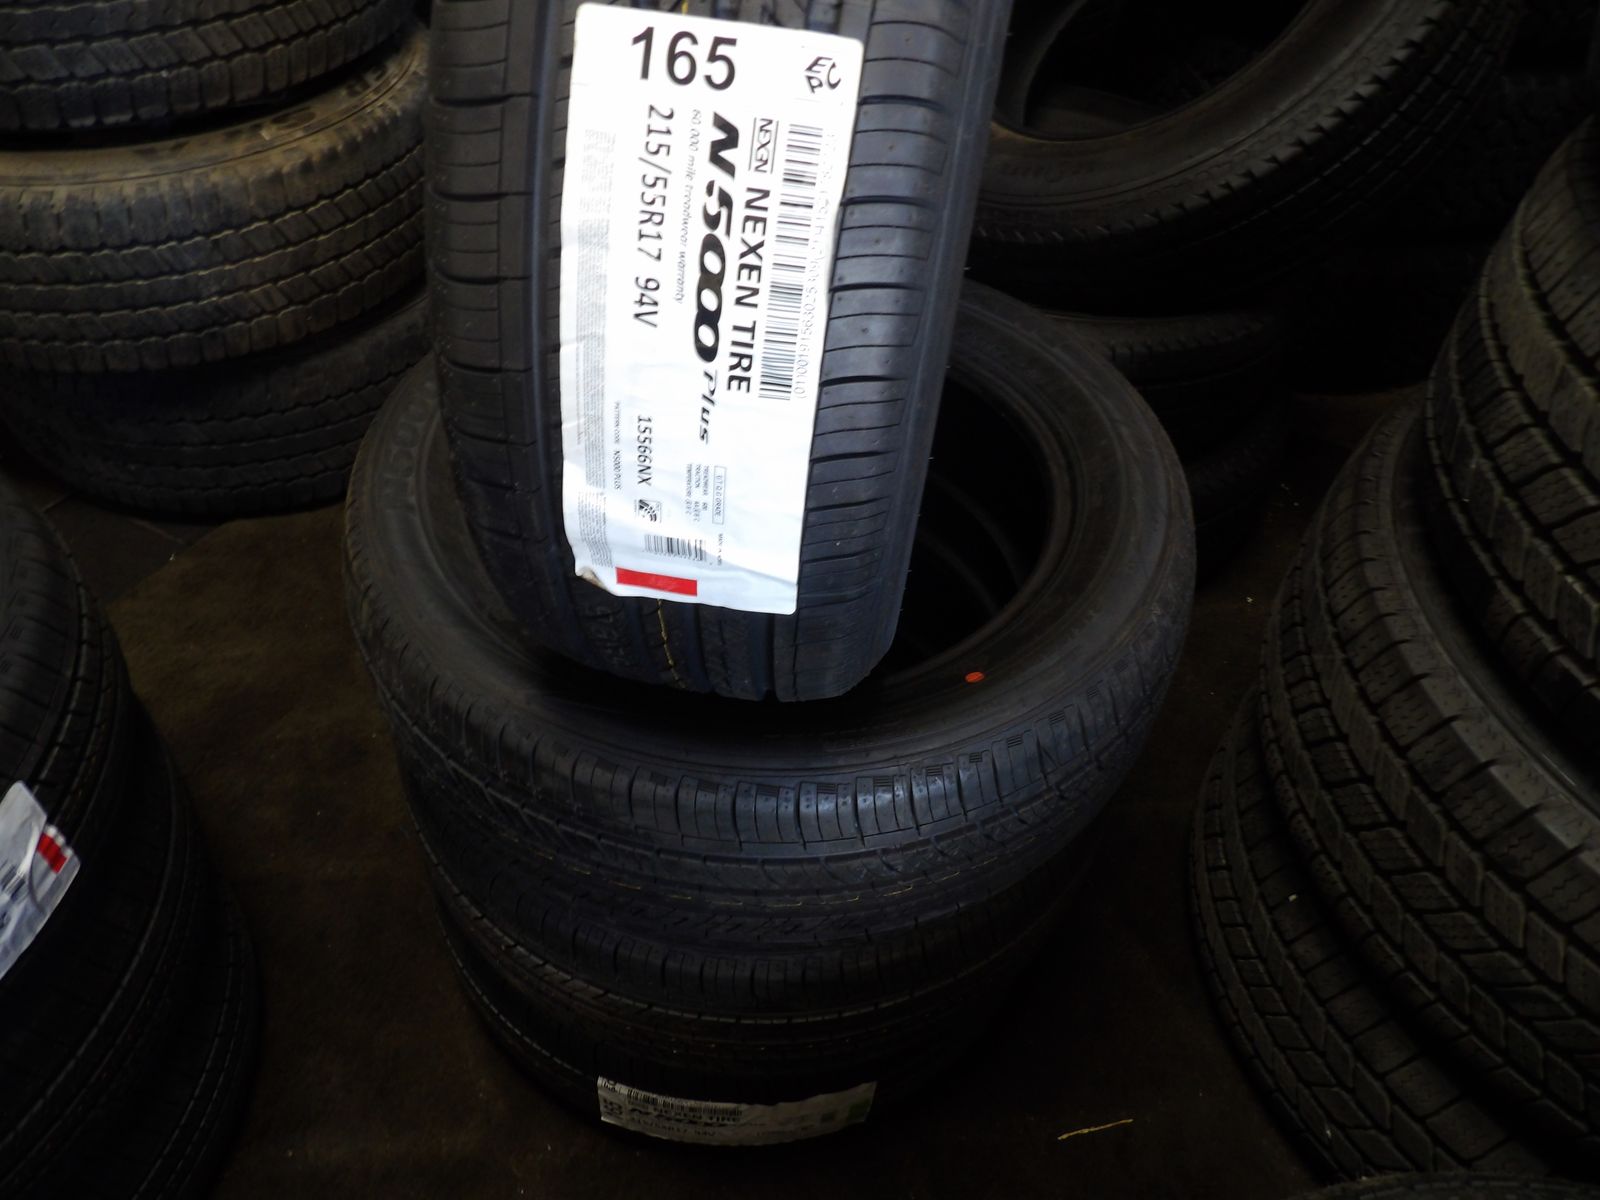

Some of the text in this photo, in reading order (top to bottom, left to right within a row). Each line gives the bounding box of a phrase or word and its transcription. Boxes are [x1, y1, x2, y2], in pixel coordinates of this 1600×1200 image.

[631, 26, 737, 91] 165
[685, 154, 695, 179] mile
[633, 104, 674, 328] 215/55R17 94V
[680, 184, 694, 247] treadwear
[675, 251, 686, 304] warranty
[694, 111, 739, 444] N5000 Plus
[727, 187, 771, 393] NEXEN TIRE
[637, 415, 652, 486] 15566NX
